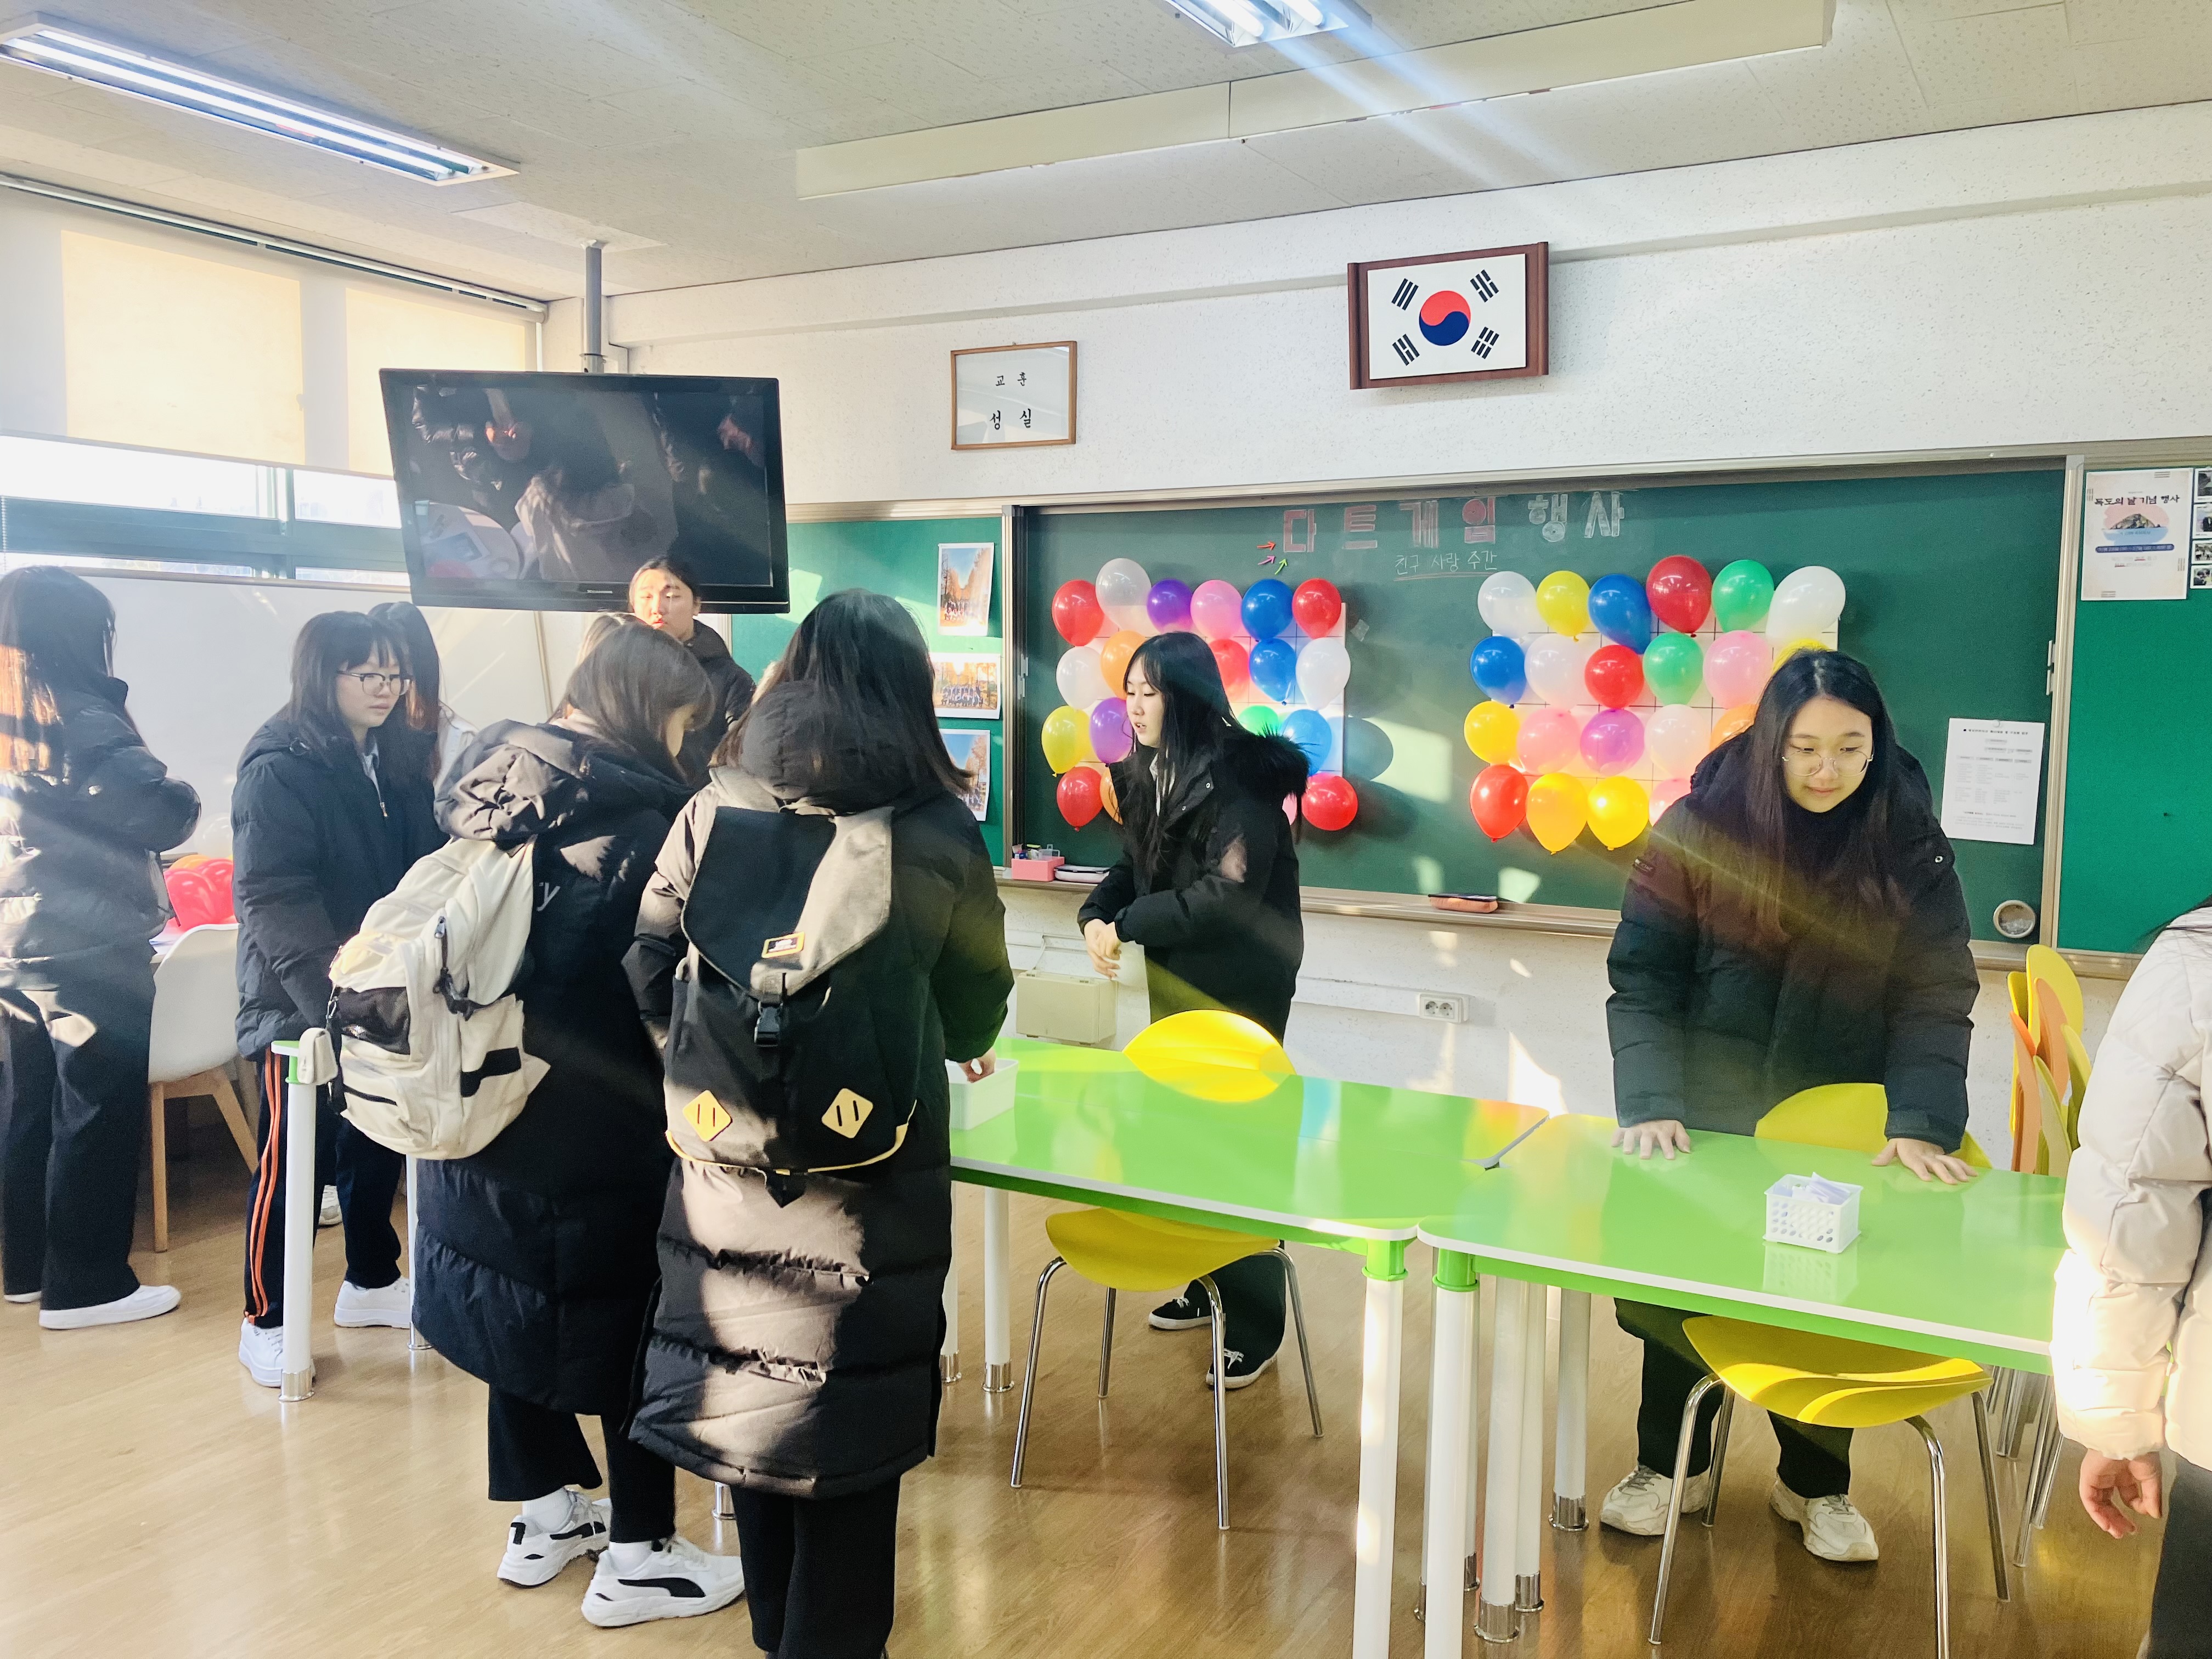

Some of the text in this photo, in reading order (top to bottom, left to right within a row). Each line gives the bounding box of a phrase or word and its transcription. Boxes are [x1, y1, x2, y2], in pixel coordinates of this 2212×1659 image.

[2094, 494, 2180, 506] 독도의 날 기념 행사
[1394, 550, 1498, 575] 친구 사랑 주간
